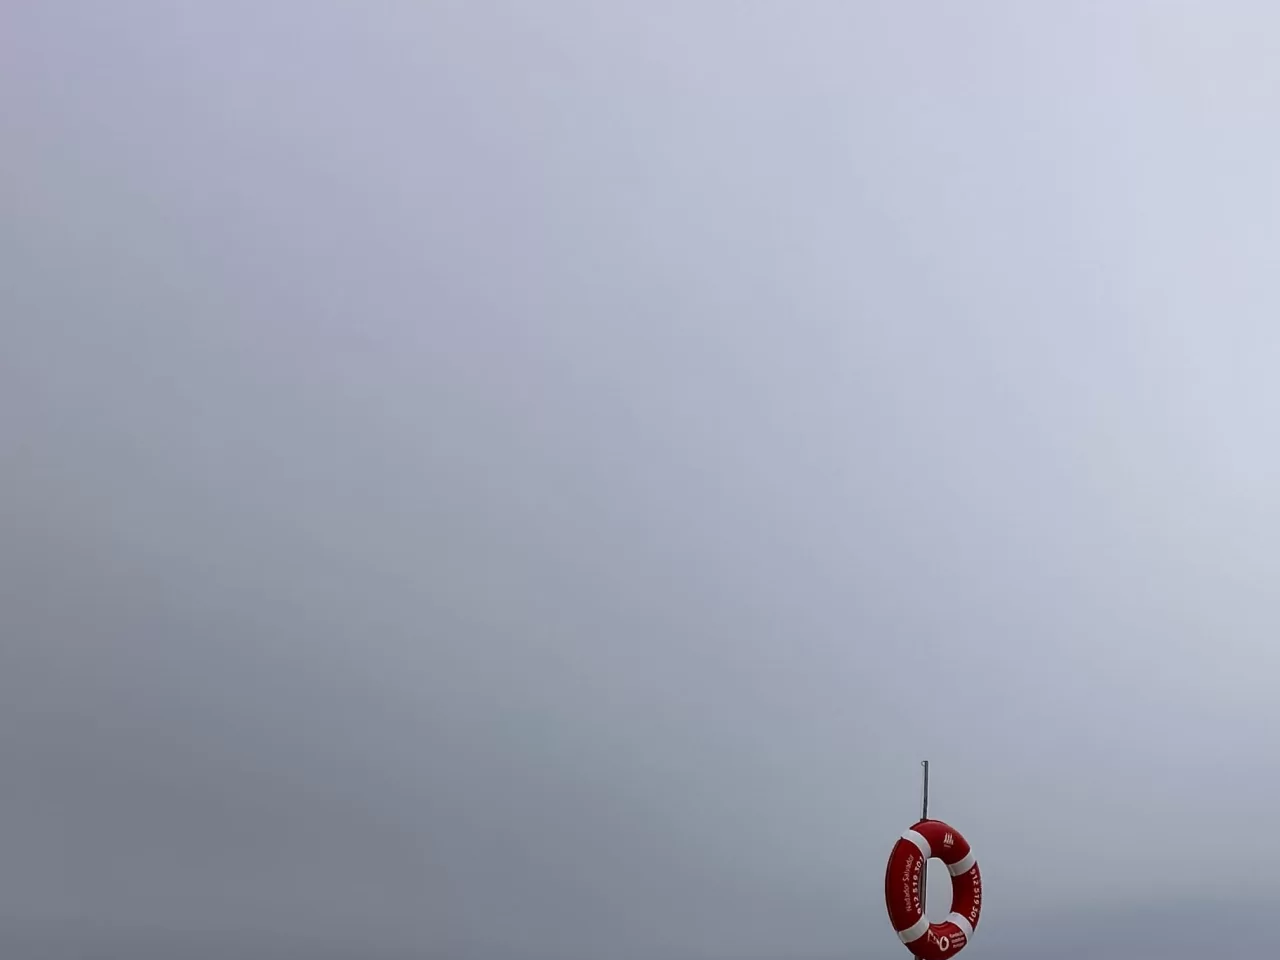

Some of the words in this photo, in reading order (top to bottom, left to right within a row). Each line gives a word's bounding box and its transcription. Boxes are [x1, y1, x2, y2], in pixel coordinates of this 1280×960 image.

[902, 854, 914, 882] Salvador
[969, 868, 979, 886] 912
[902, 883, 912, 912] Nadador
[968, 905, 978, 923] 301
